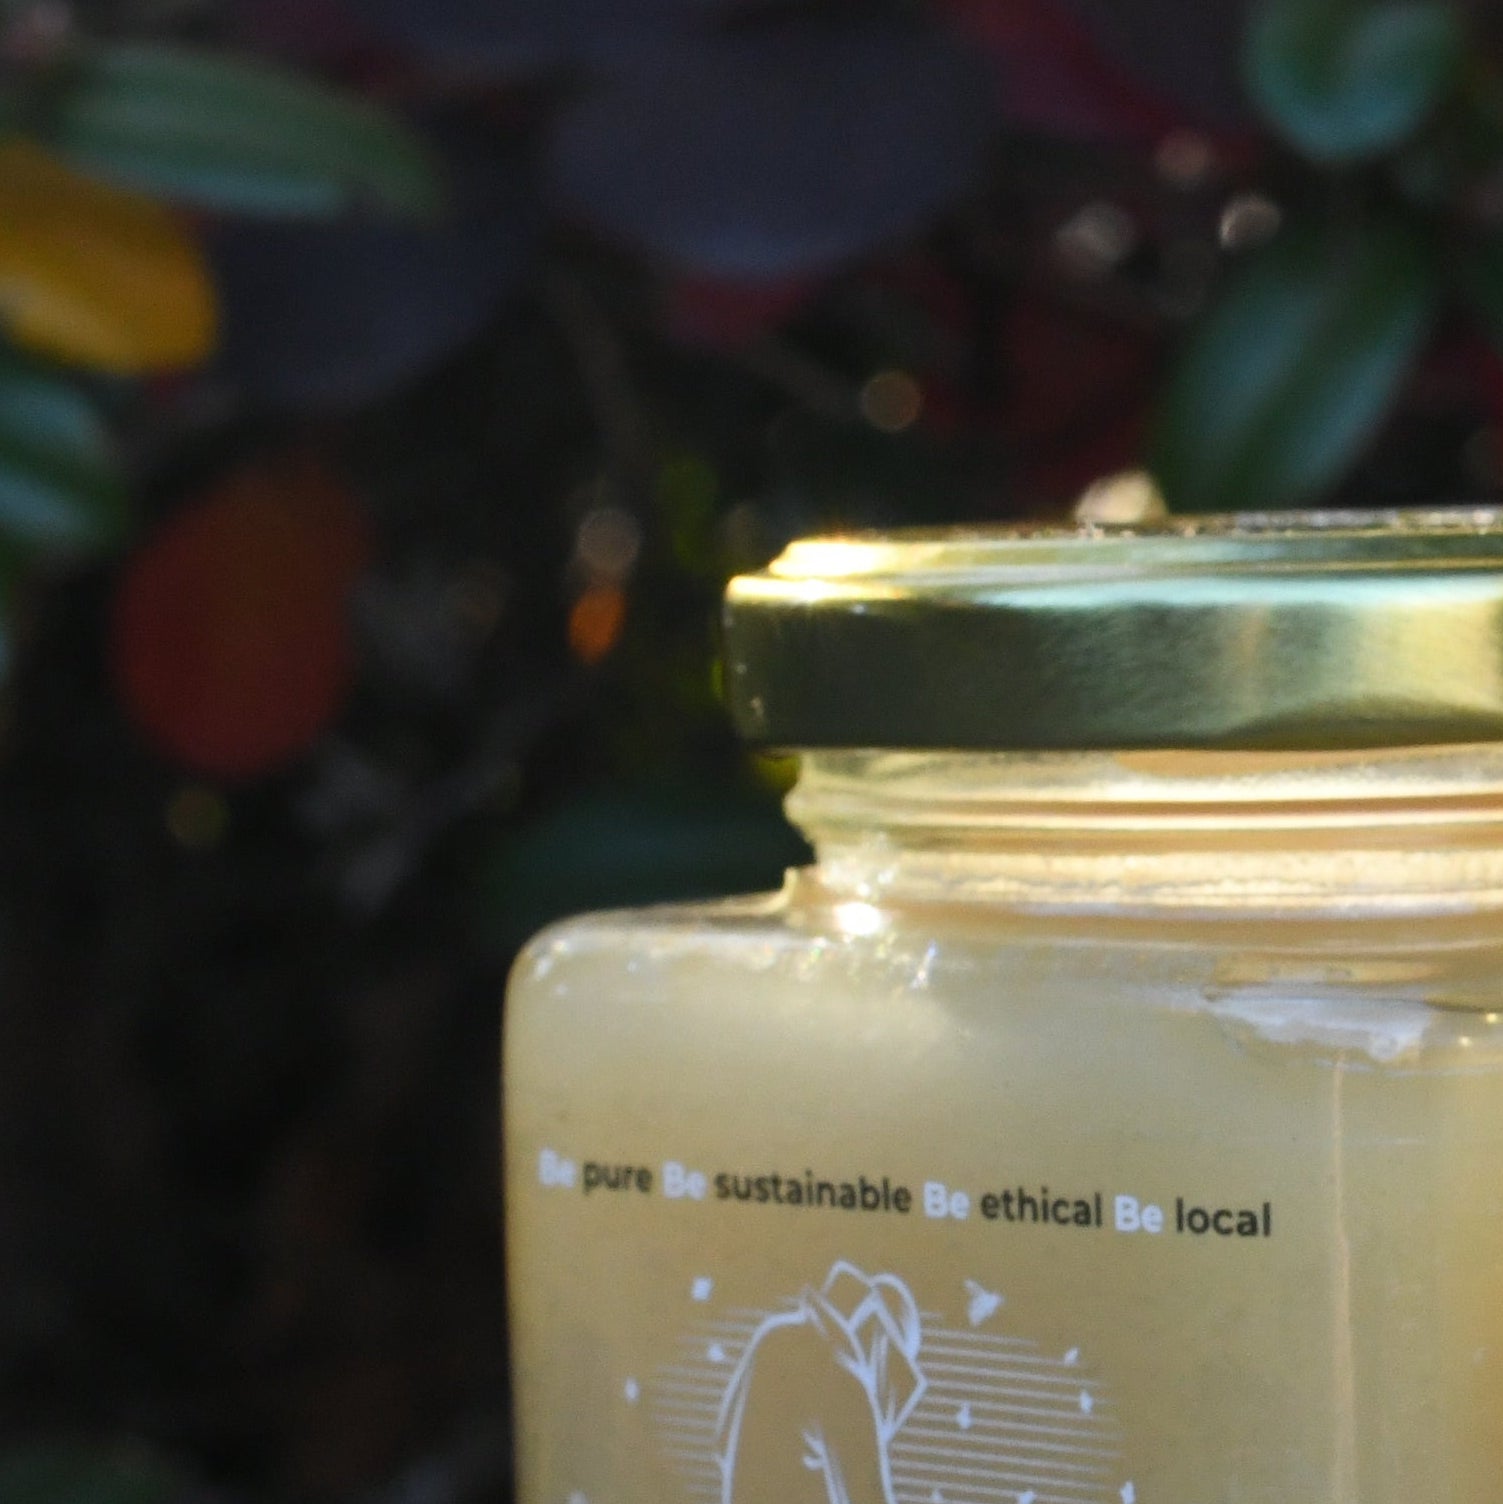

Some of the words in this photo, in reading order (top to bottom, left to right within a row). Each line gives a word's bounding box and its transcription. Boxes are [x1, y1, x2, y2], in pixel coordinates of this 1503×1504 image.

[539, 1149, 576, 1187] Be
[583, 1159, 652, 1196] pure
[662, 1161, 708, 1199] Be
[714, 1166, 912, 1215] sustainable
[924, 1181, 970, 1220] Be
[980, 1189, 1103, 1228] ethical
[1114, 1195, 1164, 1234] Be
[1176, 1201, 1272, 1238] local
